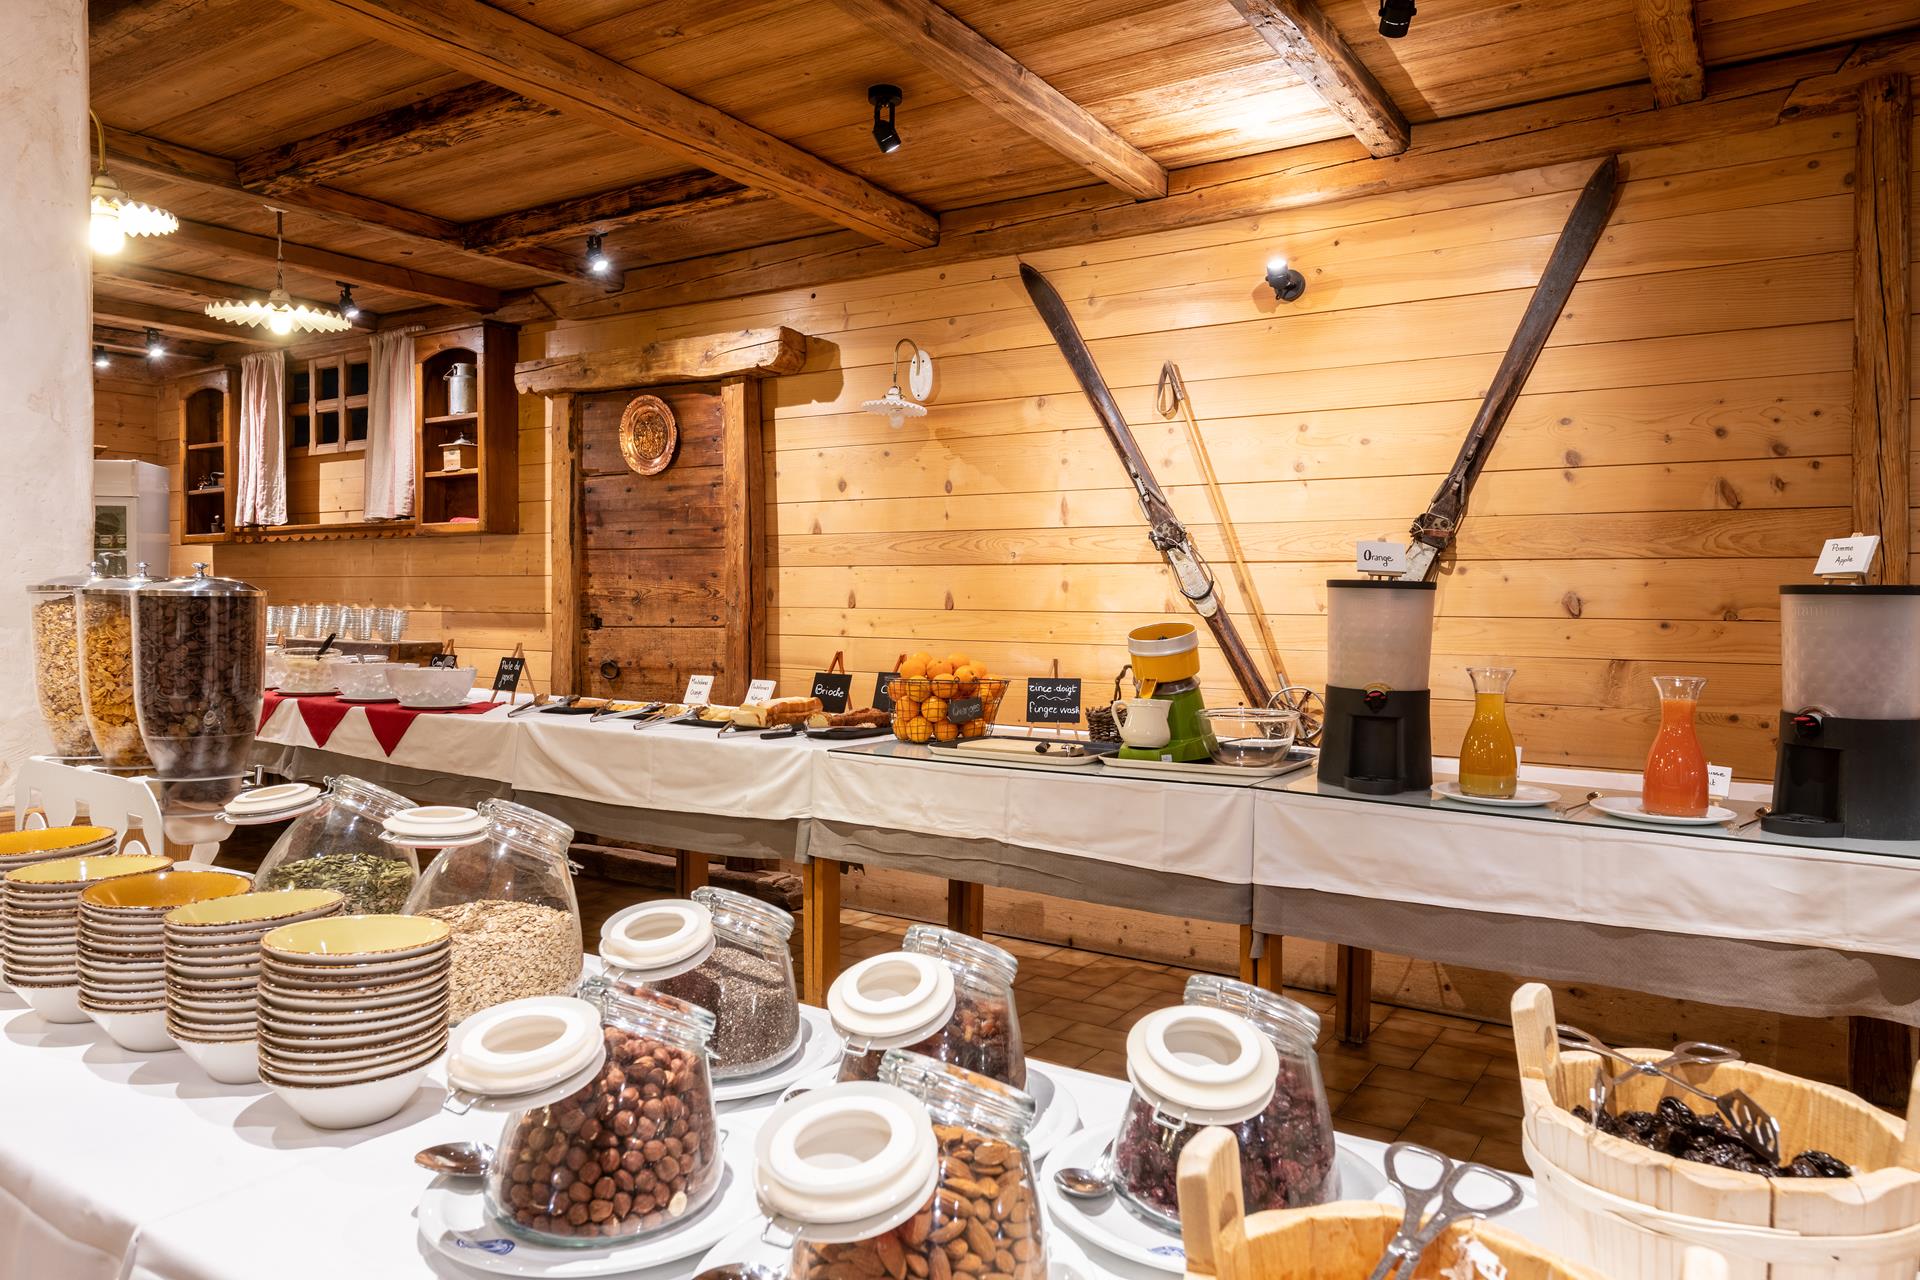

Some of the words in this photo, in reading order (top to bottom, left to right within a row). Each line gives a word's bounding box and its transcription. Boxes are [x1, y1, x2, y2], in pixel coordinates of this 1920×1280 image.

[1832, 543, 1853, 552] Pomme
[1363, 549, 1394, 567] Orange
[1835, 554, 1853, 566] Apple
[815, 683, 844, 698] Brioche
